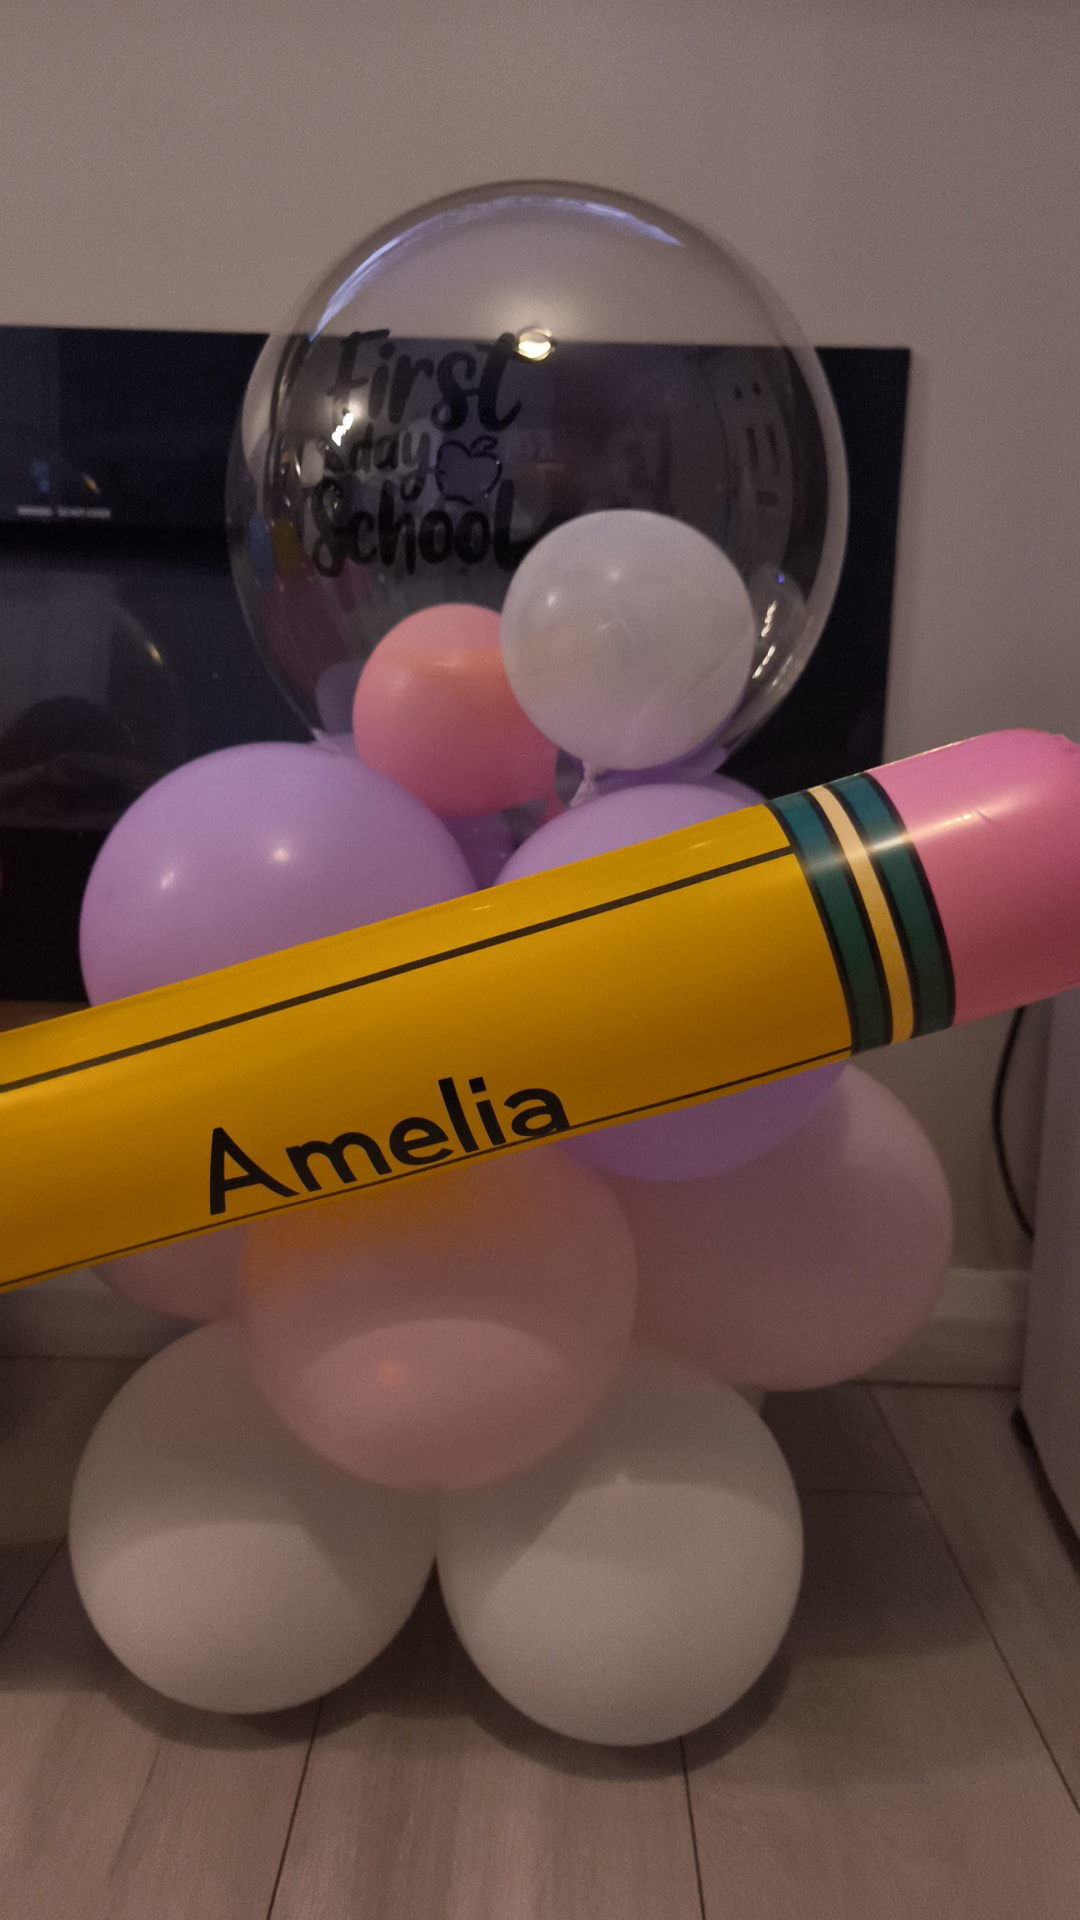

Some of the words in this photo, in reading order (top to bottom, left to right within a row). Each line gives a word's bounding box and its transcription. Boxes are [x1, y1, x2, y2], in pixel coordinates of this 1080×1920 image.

[327, 329, 522, 432] First
[348, 422, 431, 501] day
[312, 475, 533, 577] School
[210, 1077, 569, 1215] Amelia
